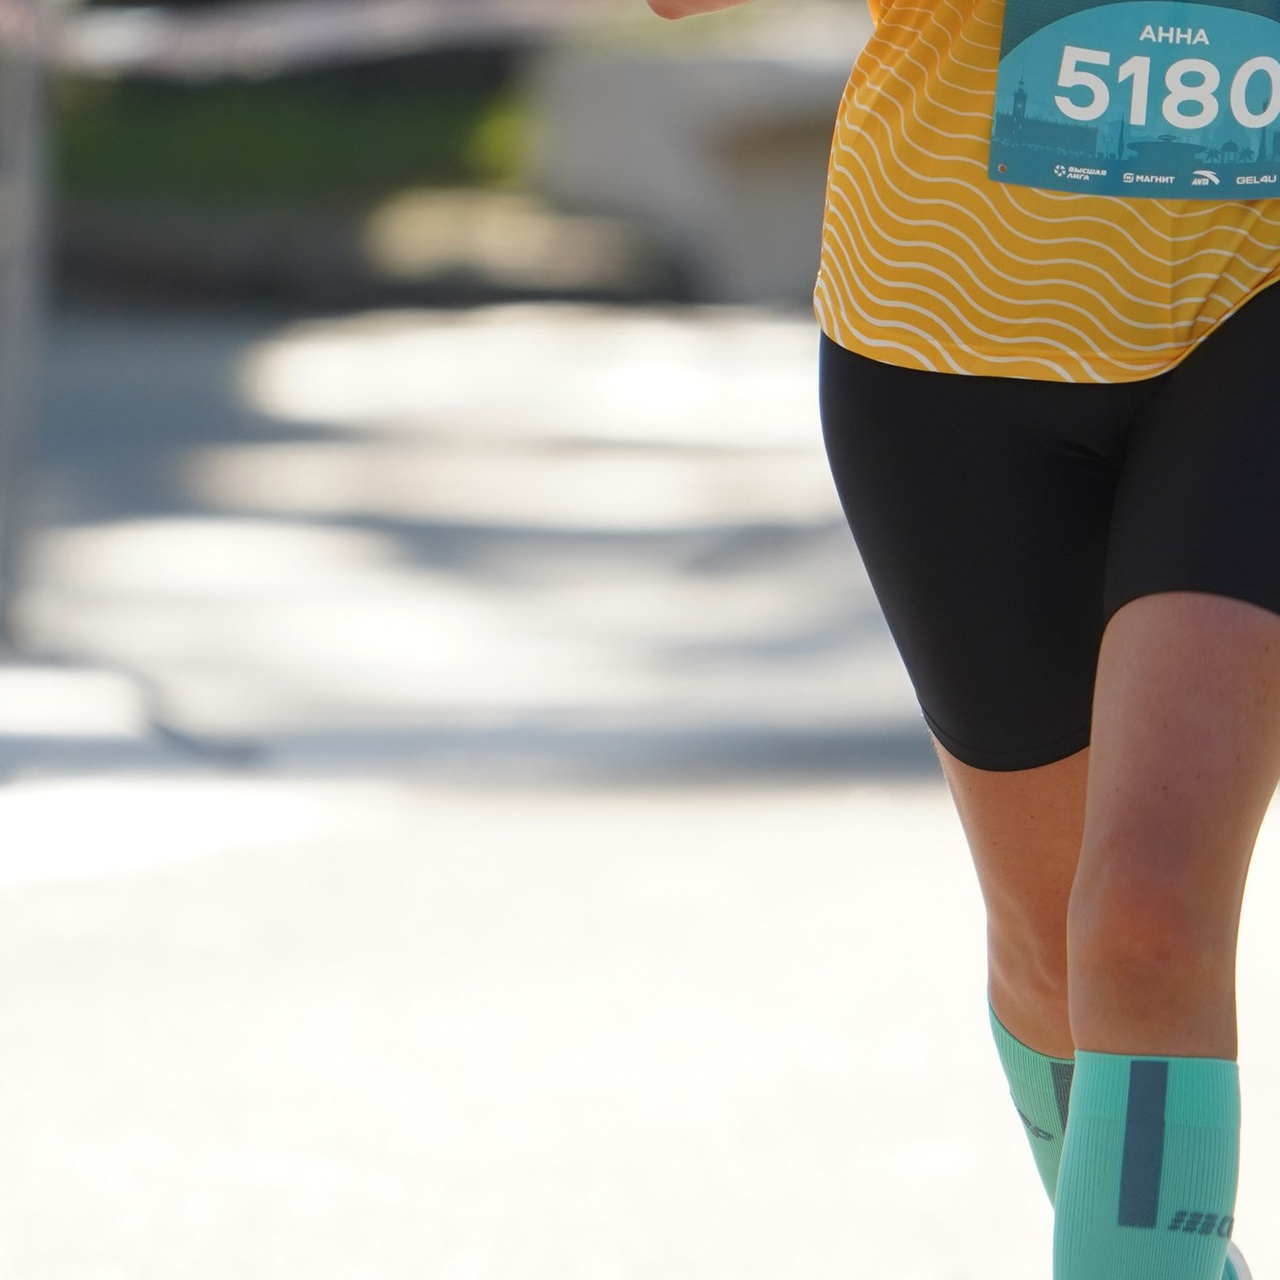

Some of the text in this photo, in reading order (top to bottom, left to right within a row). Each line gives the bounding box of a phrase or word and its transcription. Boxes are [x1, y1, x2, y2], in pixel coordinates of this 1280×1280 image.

[1139, 24, 1210, 46] АННА
[1066, 173, 1090, 181] ЛИГА
[1068, 166, 1108, 177] ВЫСШАЯ
[1135, 174, 1176, 185] МАГНИТ
[1191, 177, 1210, 186] ANTA
[1235, 174, 1278, 185] GEL4U
